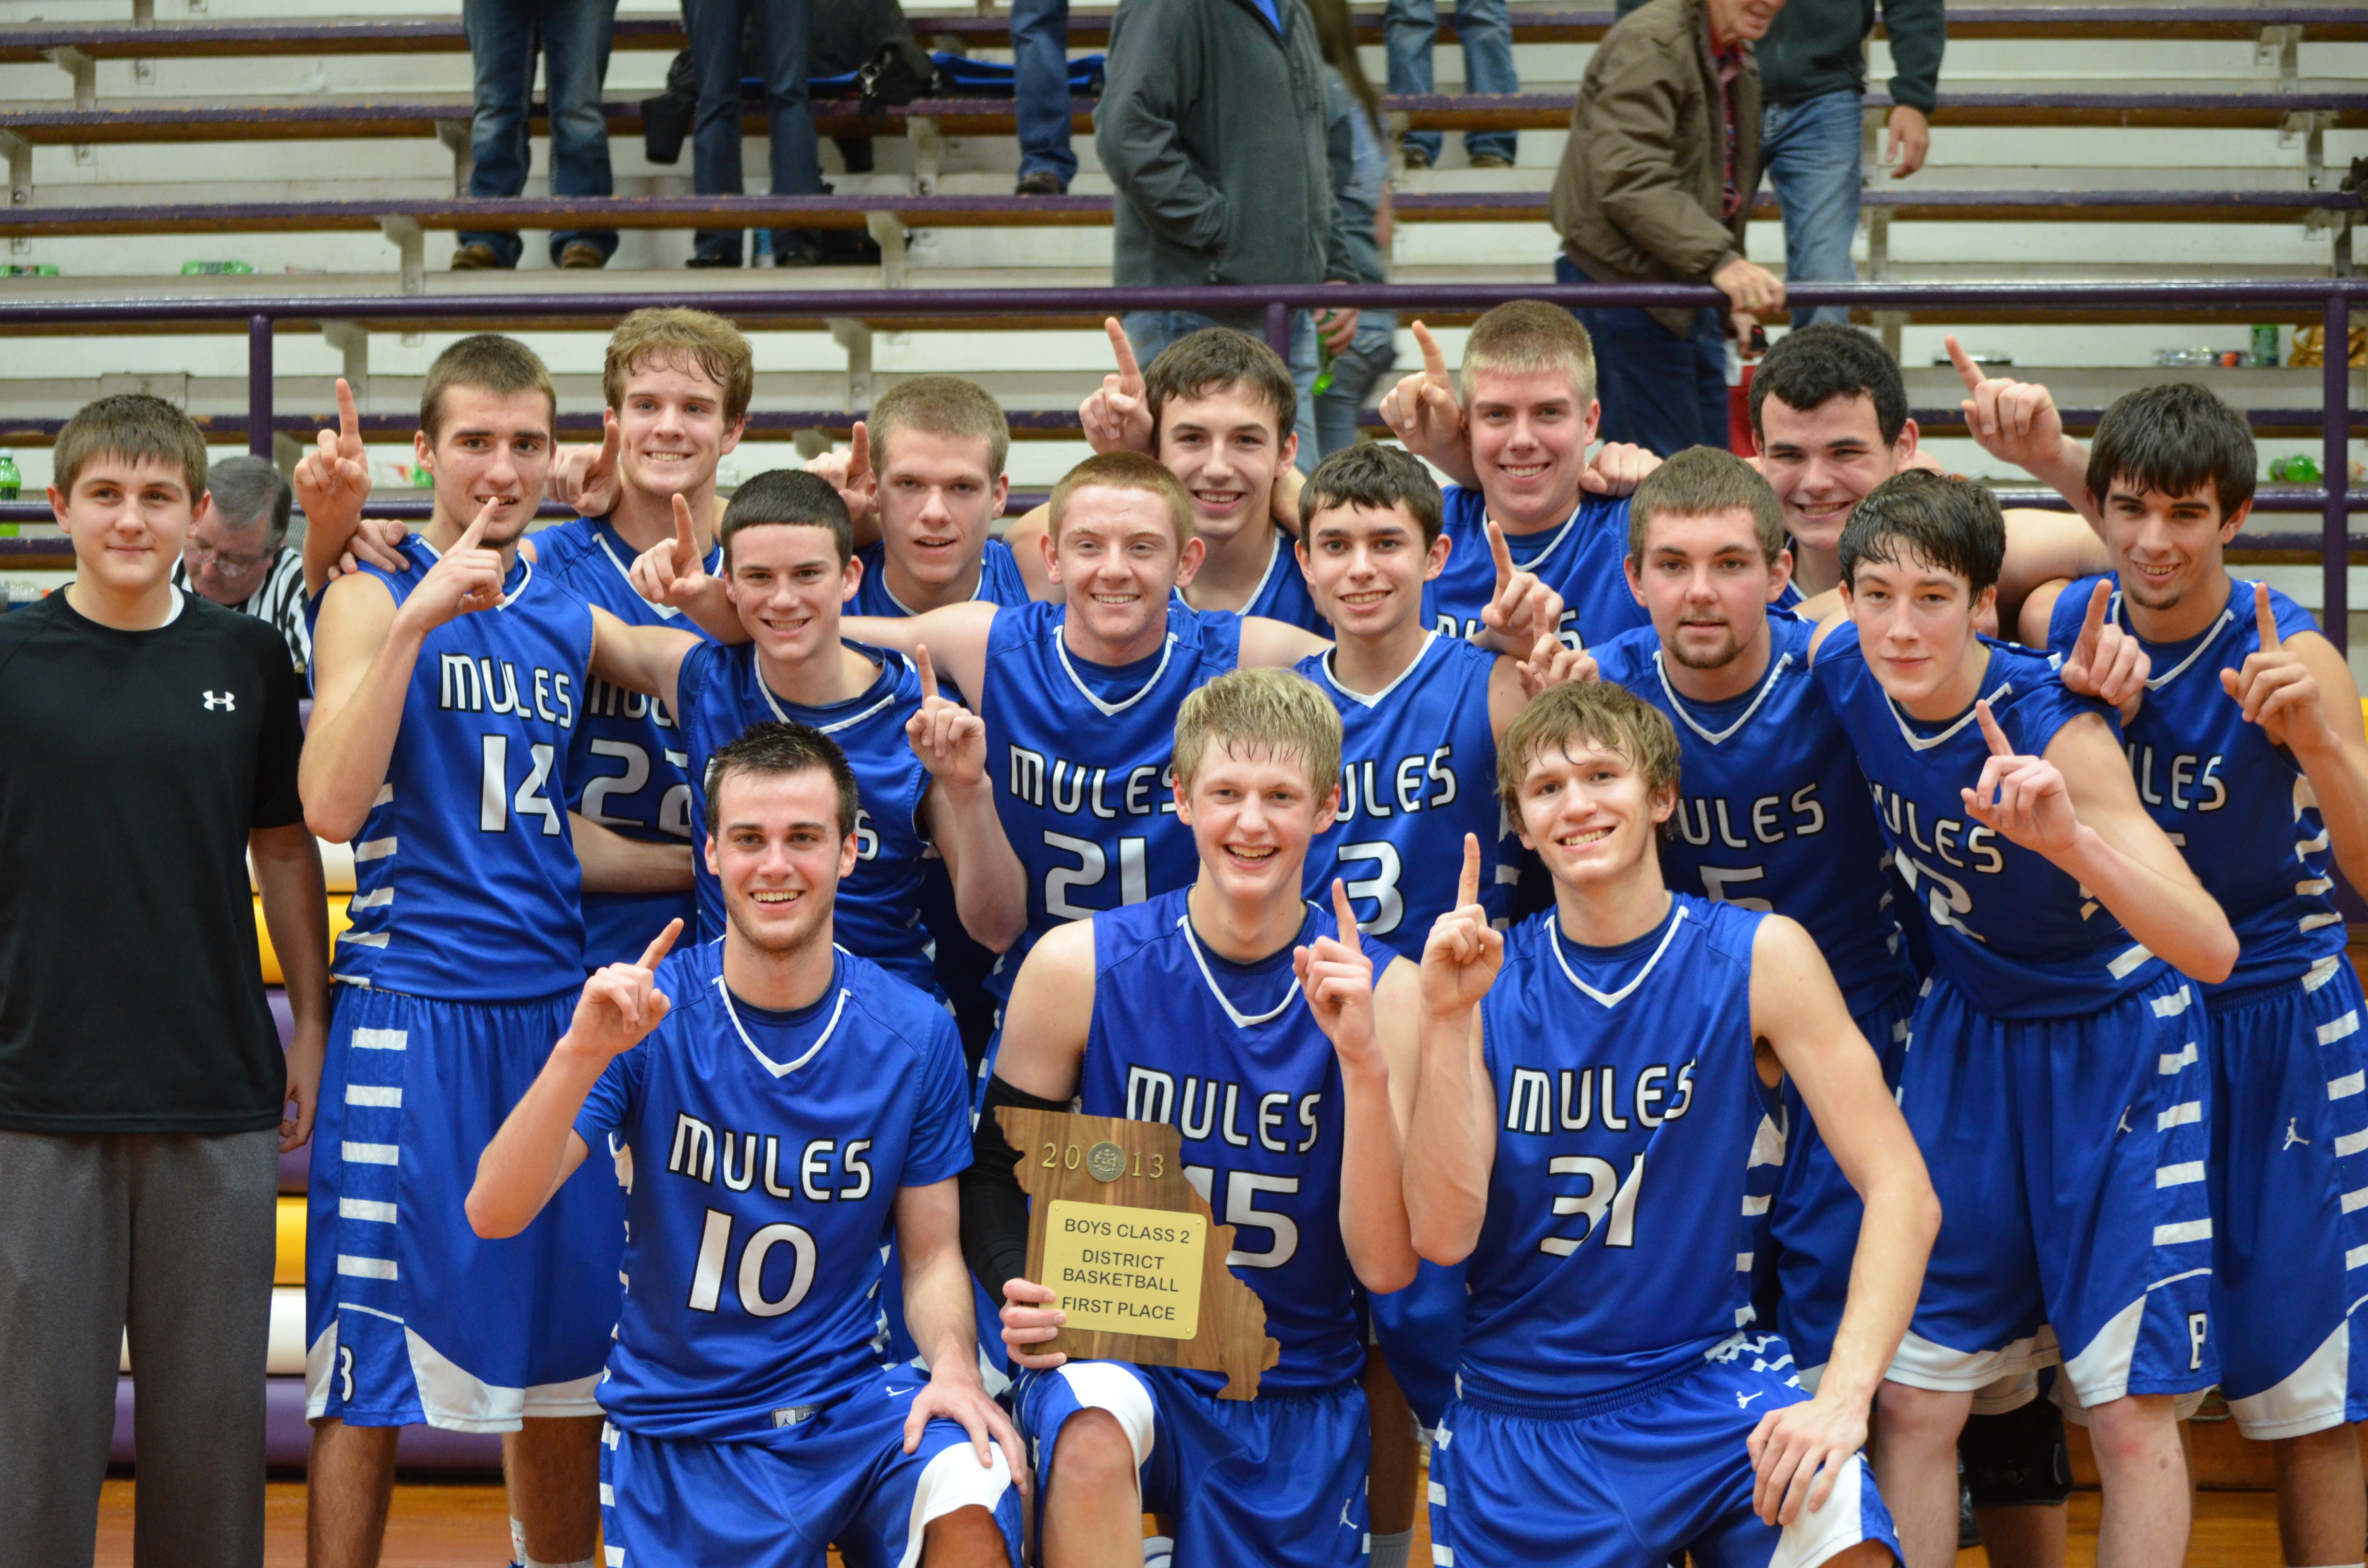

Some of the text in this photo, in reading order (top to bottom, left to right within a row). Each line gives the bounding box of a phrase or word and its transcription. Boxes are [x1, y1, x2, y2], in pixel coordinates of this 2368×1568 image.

[439, 652, 572, 729] MULES
[481, 734, 561, 836] 14
[1334, 745, 1457, 822] ULES
[1666, 782, 1825, 849] ULES
[1043, 830, 1148, 921] 21
[1338, 840, 1404, 936] 3
[1126, 1065, 1321, 1152] MULES
[1506, 1055, 1697, 1134] MULES
[668, 1112, 872, 1201] MULES
[1064, 1218, 1190, 1244] BOYS CLASS 2
[1540, 1152, 1645, 1257] 31
[687, 1207, 817, 1318] 10
[1062, 1268, 1179, 1292] BASKETBALL
[1082, 1249, 1165, 1270] DISTRICT
[1062, 1297, 1175, 1321] FIRST PLACE
